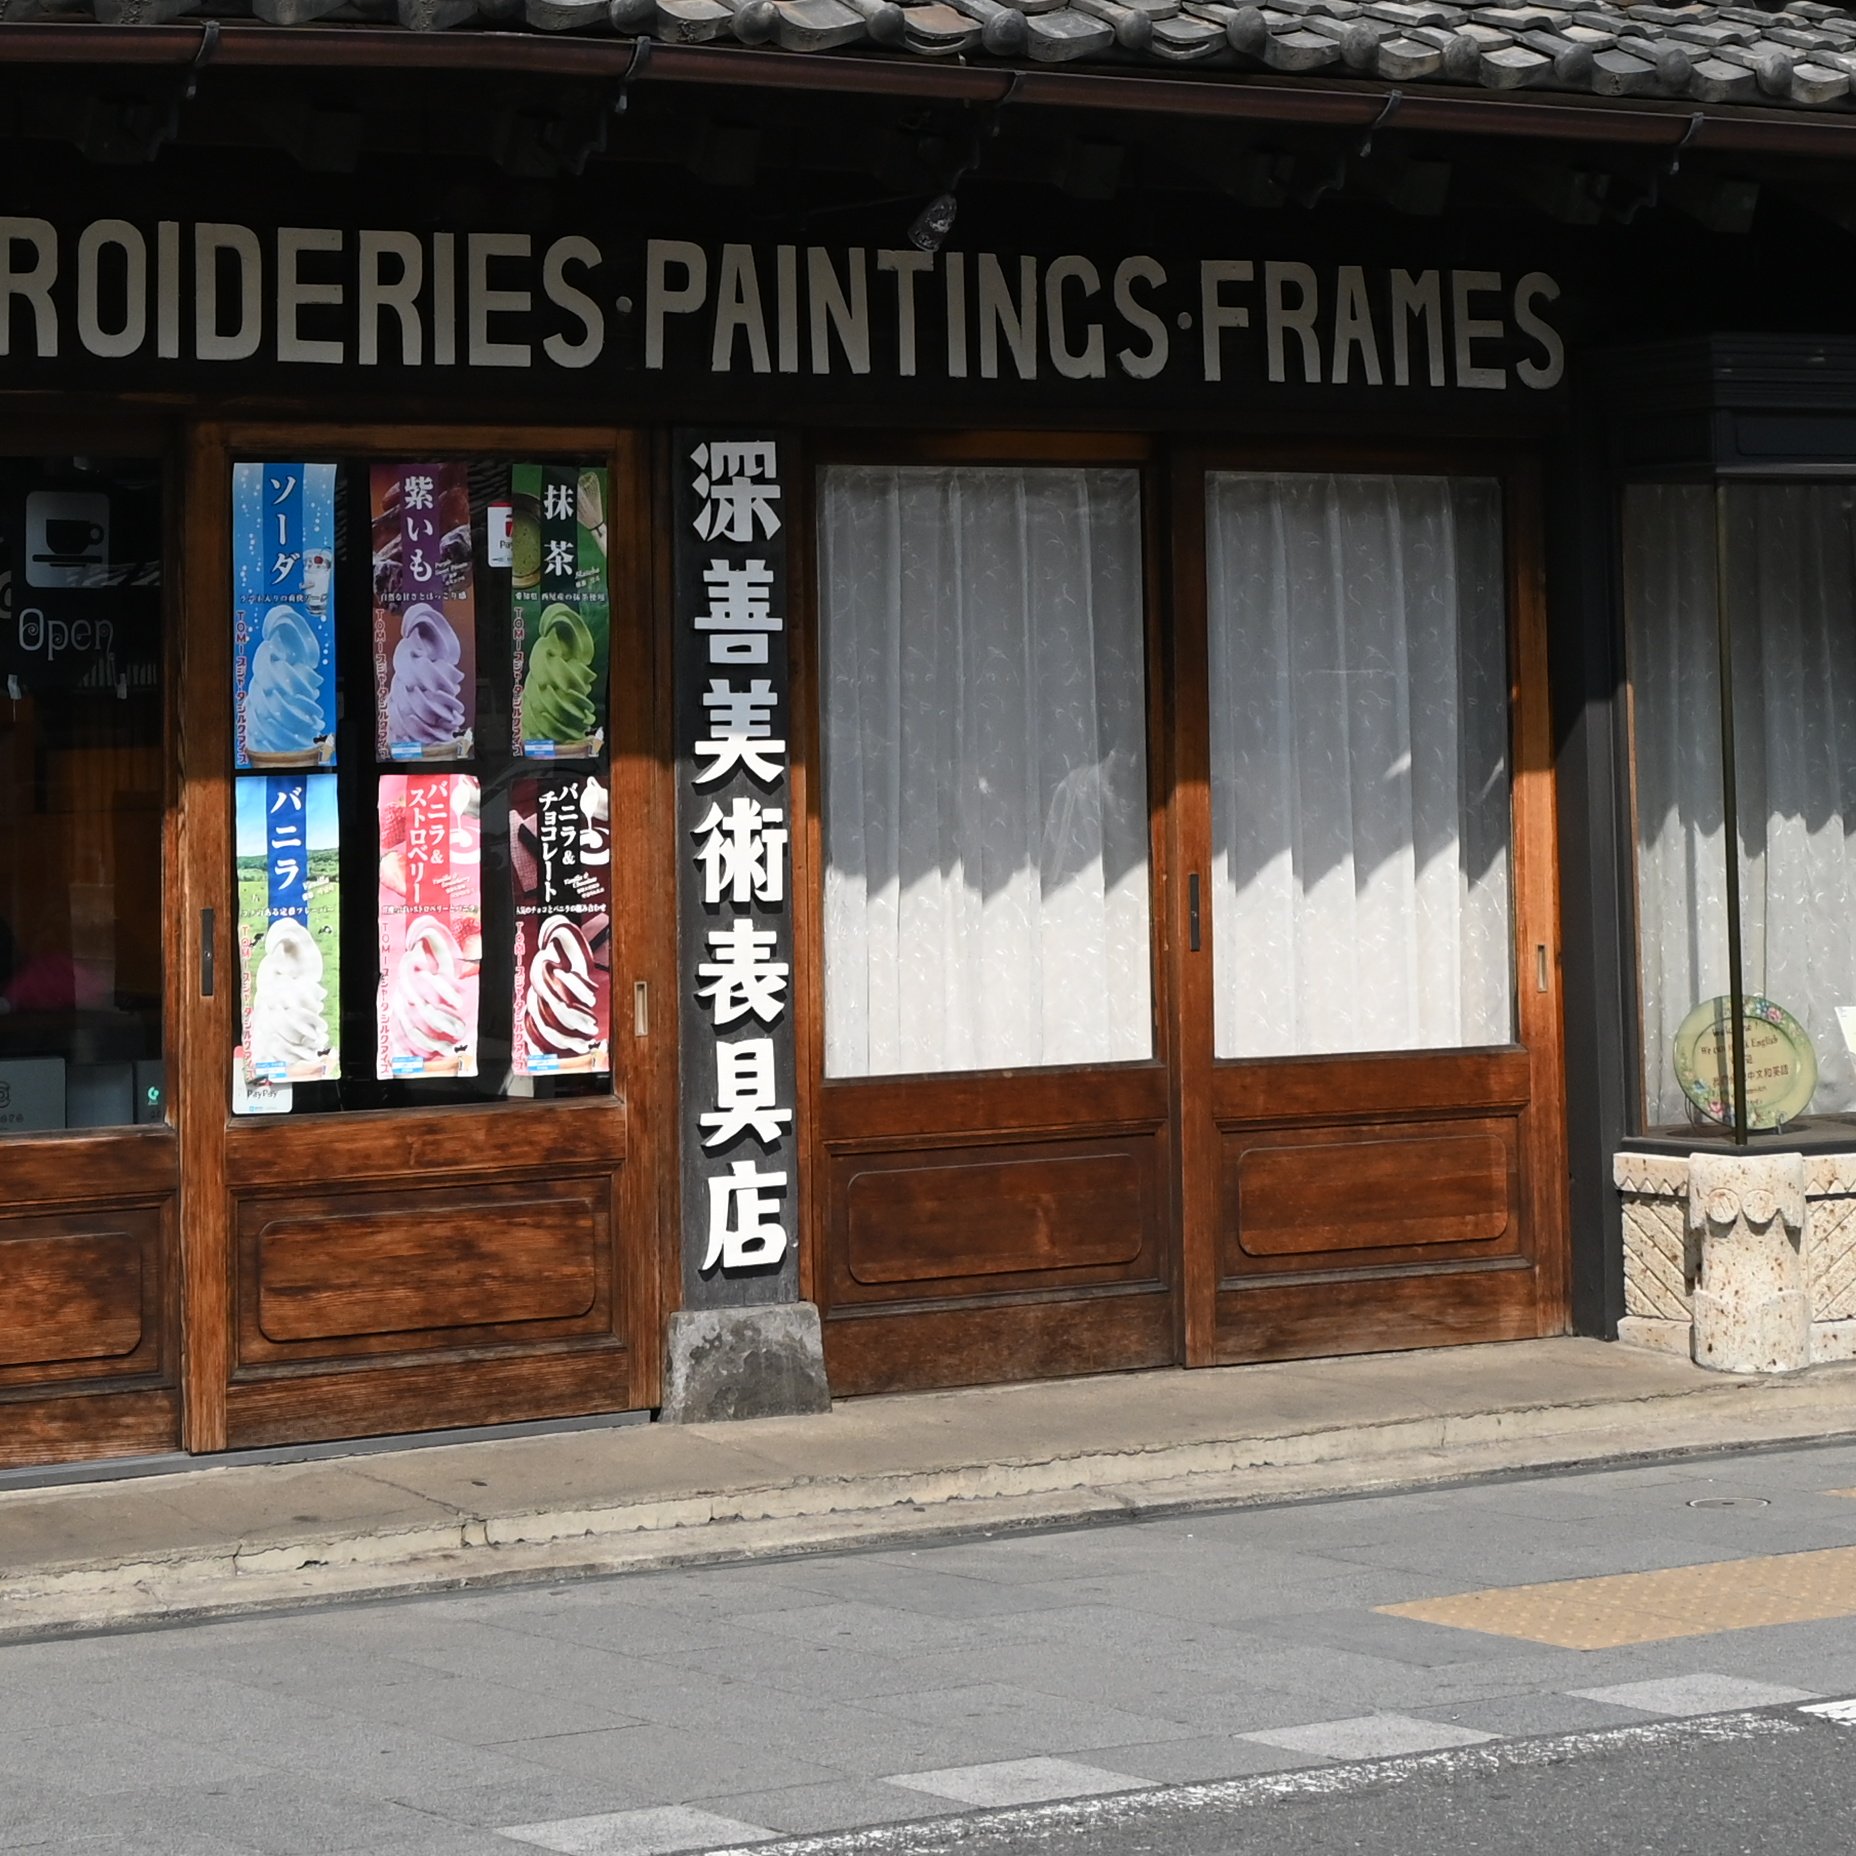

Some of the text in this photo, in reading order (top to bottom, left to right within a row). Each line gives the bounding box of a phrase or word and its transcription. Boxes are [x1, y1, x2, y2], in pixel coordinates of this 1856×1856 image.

[644, 238, 1168, 380] PAINTINGS
[1201, 259, 1566, 390] FRAMES
[270, 475, 301, 585] ソーダ
[404, 475, 434, 582] 紫いも
[543, 484, 575, 576] 抹茶
[17, 606, 117, 662] Open
[270, 786, 302, 891] バニラ
[407, 788, 429, 904] ストロベリー
[538, 790, 558, 903] チョコレート
[690, 440, 793, 1272] 深善美術表具店
[247, 1088, 278, 1100] PayPay
